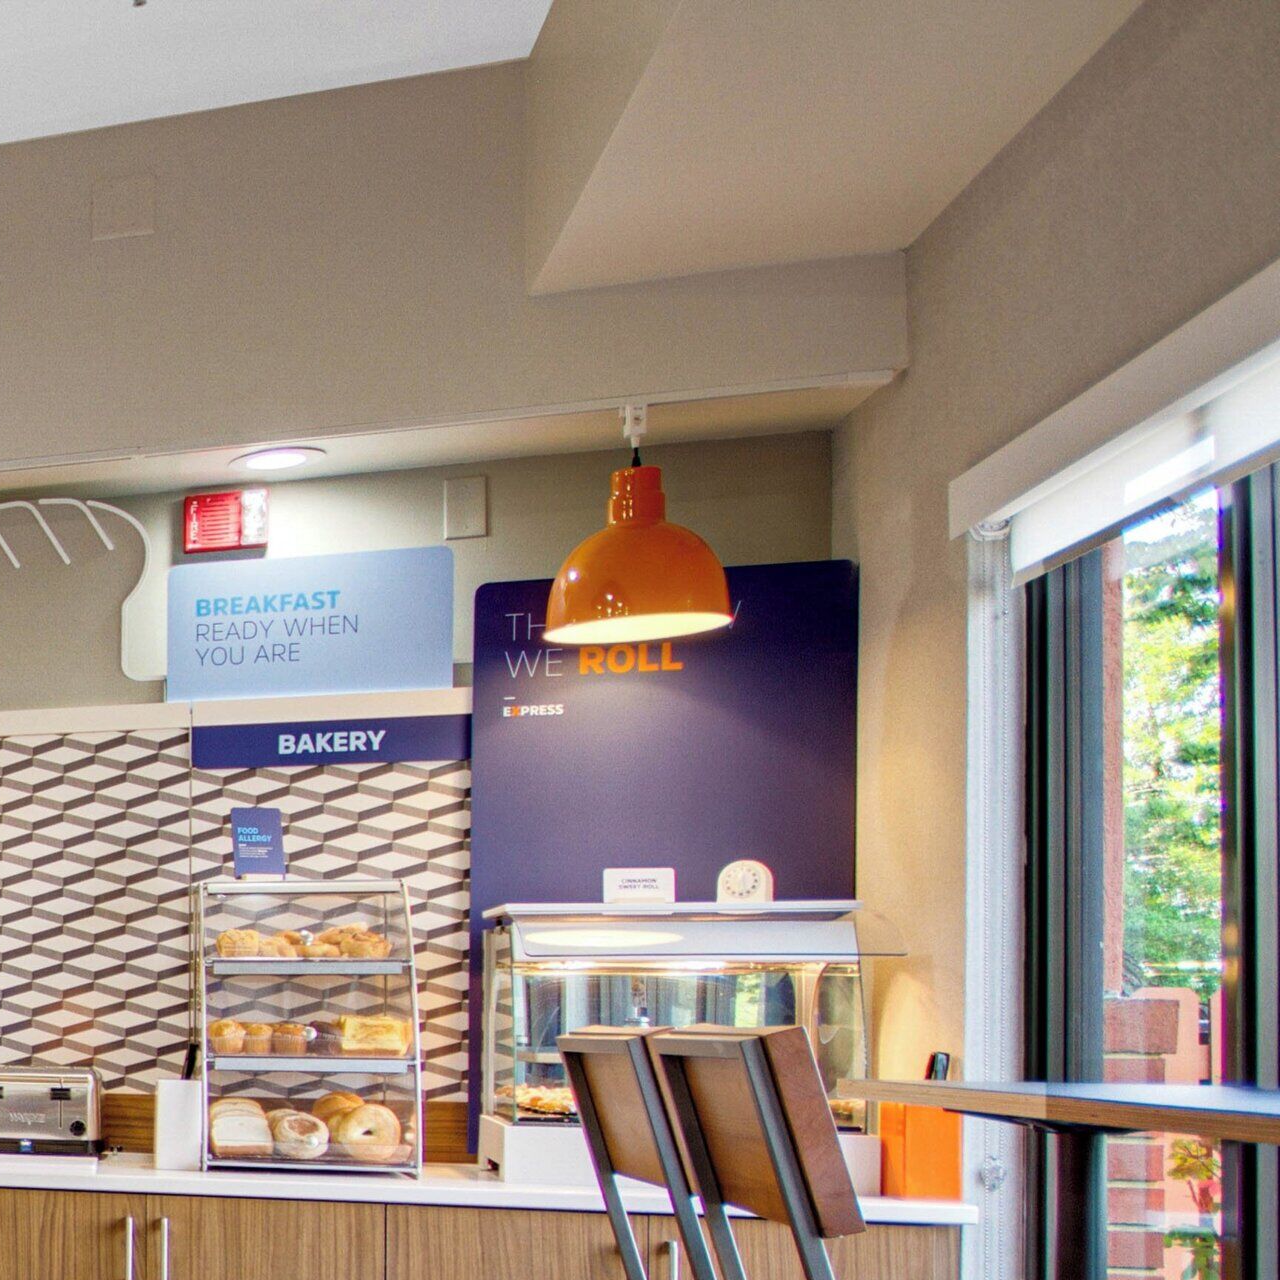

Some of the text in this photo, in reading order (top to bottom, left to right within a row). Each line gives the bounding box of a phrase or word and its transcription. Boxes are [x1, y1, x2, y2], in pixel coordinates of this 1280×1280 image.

[196, 590, 341, 617] BREAKFAST
[196, 614, 359, 642] READY WHEN
[195, 643, 301, 667] YOU ARE
[505, 643, 684, 678] WE ROLL
[503, 705, 564, 717] EXPRESS
[278, 730, 386, 755] BAKERY
[238, 834, 272, 842] ALLERGY
